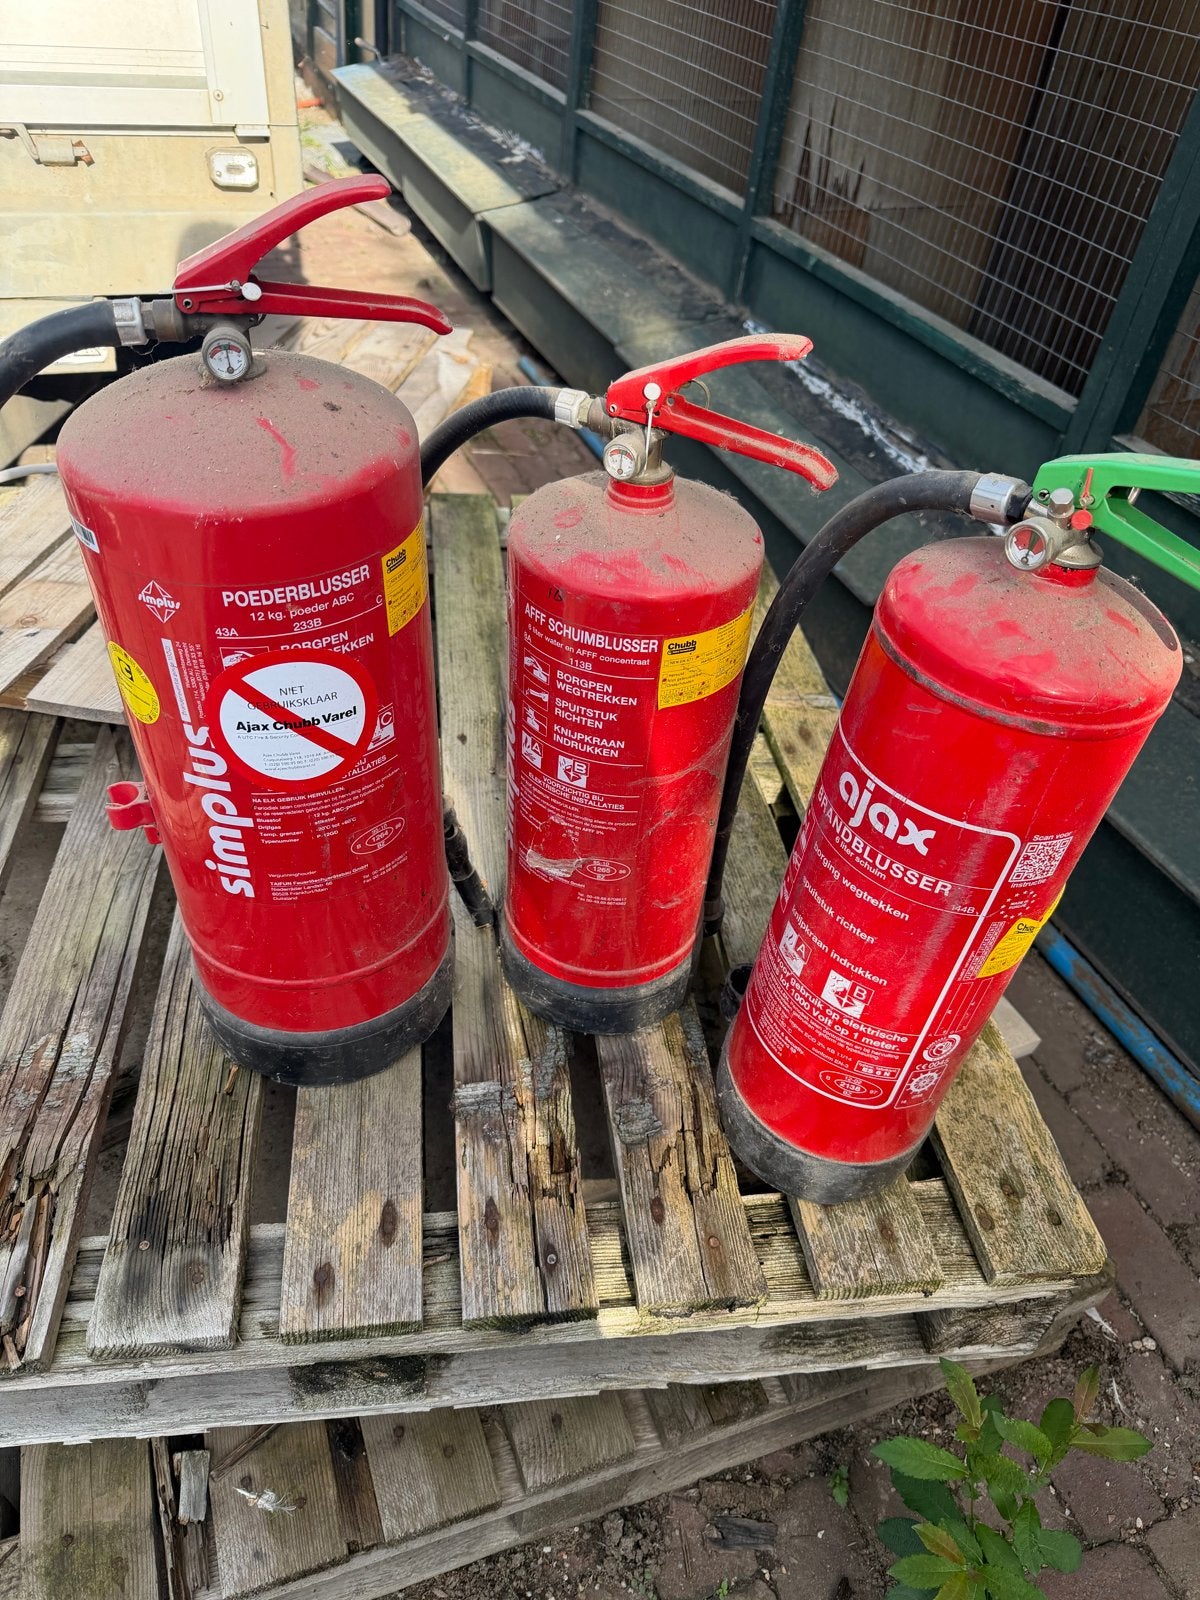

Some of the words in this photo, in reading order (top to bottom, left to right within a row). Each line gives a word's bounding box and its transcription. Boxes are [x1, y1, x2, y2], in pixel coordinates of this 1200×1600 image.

[222, 564, 371, 607] POEDERBLUSSER
[138, 592, 180, 610] simplus
[250, 612, 265, 621] 12
[268, 611, 286, 621] kg.
[289, 601, 329, 619] poeder
[332, 592, 355, 608] ABC
[215, 627, 239, 637] 43A
[293, 617, 323, 632] 233B
[524, 602, 547, 626] AFFF
[548, 617, 659, 653] SCHUIMBLUSSER
[575, 648, 598, 659] AFFF
[599, 654, 650, 666] concentraat
[667, 640, 697, 651] Chubb
[569, 657, 593, 671] 113B
[279, 685, 305, 696] NIET
[556, 669, 613, 693] BORGPEN
[556, 680, 638, 706] WEGTREKKEN
[247, 691, 338, 711] GEBRUIKSKLAAR
[555, 697, 619, 721] SPUITSTUK
[236, 721, 270, 733] Ajax
[272, 716, 321, 731] Chubb
[322, 706, 357, 723] Varel
[380, 711, 392, 724] C
[554, 707, 603, 730] RICHTEN
[553, 723, 625, 749] KNIJPKRAAN
[553, 733, 619, 758] INDRUKKEN
[574, 761, 587, 774] B
[528, 771, 570, 799] ELEKTRISCHE
[571, 795, 625, 810] INSTALLATIES
[542, 775, 591, 799] VOORZICHTIG
[591, 794, 604, 802] BIJ
[183, 723, 255, 897] simplus
[839, 771, 937, 856] ajax
[817, 786, 953, 897] BRANDBLUSSER
[1032, 834, 1054, 842] Scan
[1055, 831, 1073, 840] voor
[840, 841, 854, 858] liter
[855, 856, 887, 881] schuim
[813, 841, 841, 880] borging
[842, 877, 910, 921] wegtrekken
[802, 875, 835, 919] spuitstuk
[836, 914, 876, 945] richten
[792, 904, 830, 953] knijpkraan
[830, 949, 888, 987] indrukken
[797, 944, 806, 959] A
[853, 986, 867, 1001] B
[790, 977, 824, 1010] gebruik
[825, 1008, 840, 1021] op
[842, 1017, 909, 1043] elektrische
[790, 988, 811, 1010] 1000
[811, 1008, 833, 1027] Volt
[833, 1024, 849, 1037] op
[861, 1036, 900, 1051] meter.
